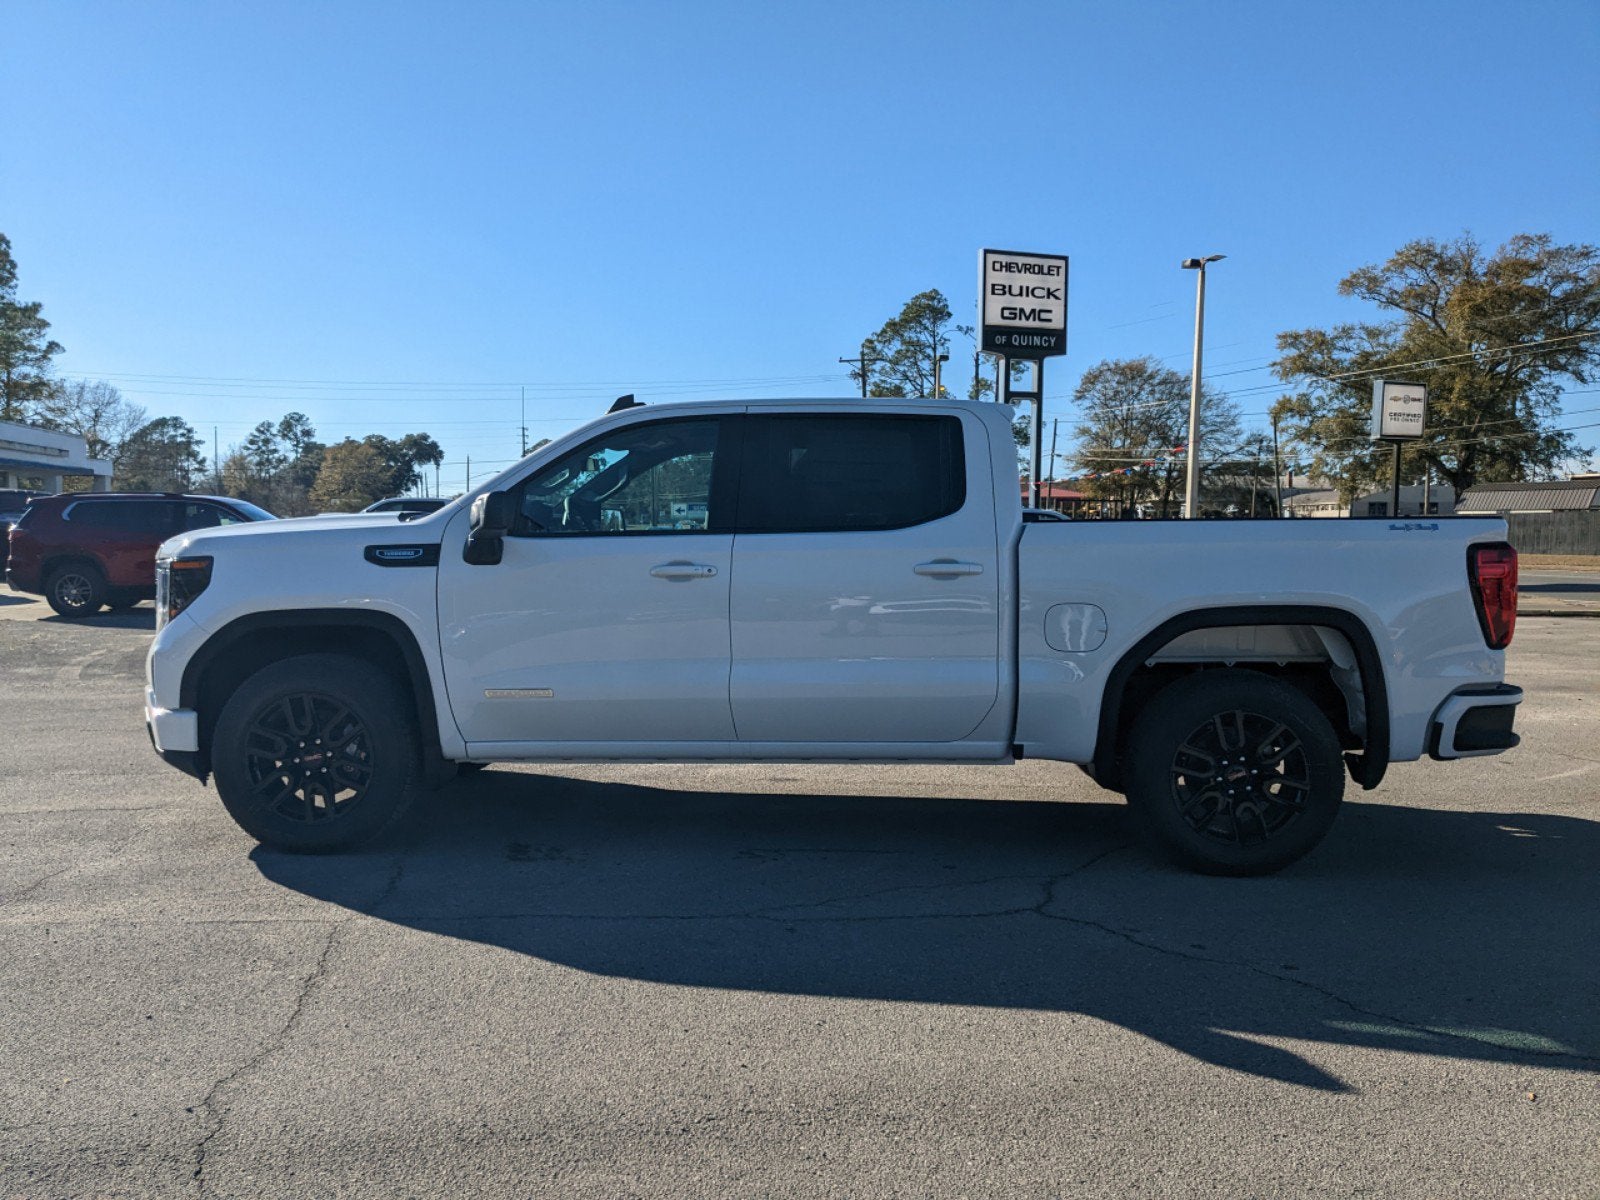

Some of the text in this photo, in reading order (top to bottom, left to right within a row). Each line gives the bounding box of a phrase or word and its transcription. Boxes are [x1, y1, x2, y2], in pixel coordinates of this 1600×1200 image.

[992, 260, 1062, 277] CHEVROLET
[990, 283, 1062, 301] BUICK
[1000, 306, 1053, 323] GMC
[994, 334, 1056, 347] OF QUINCY
